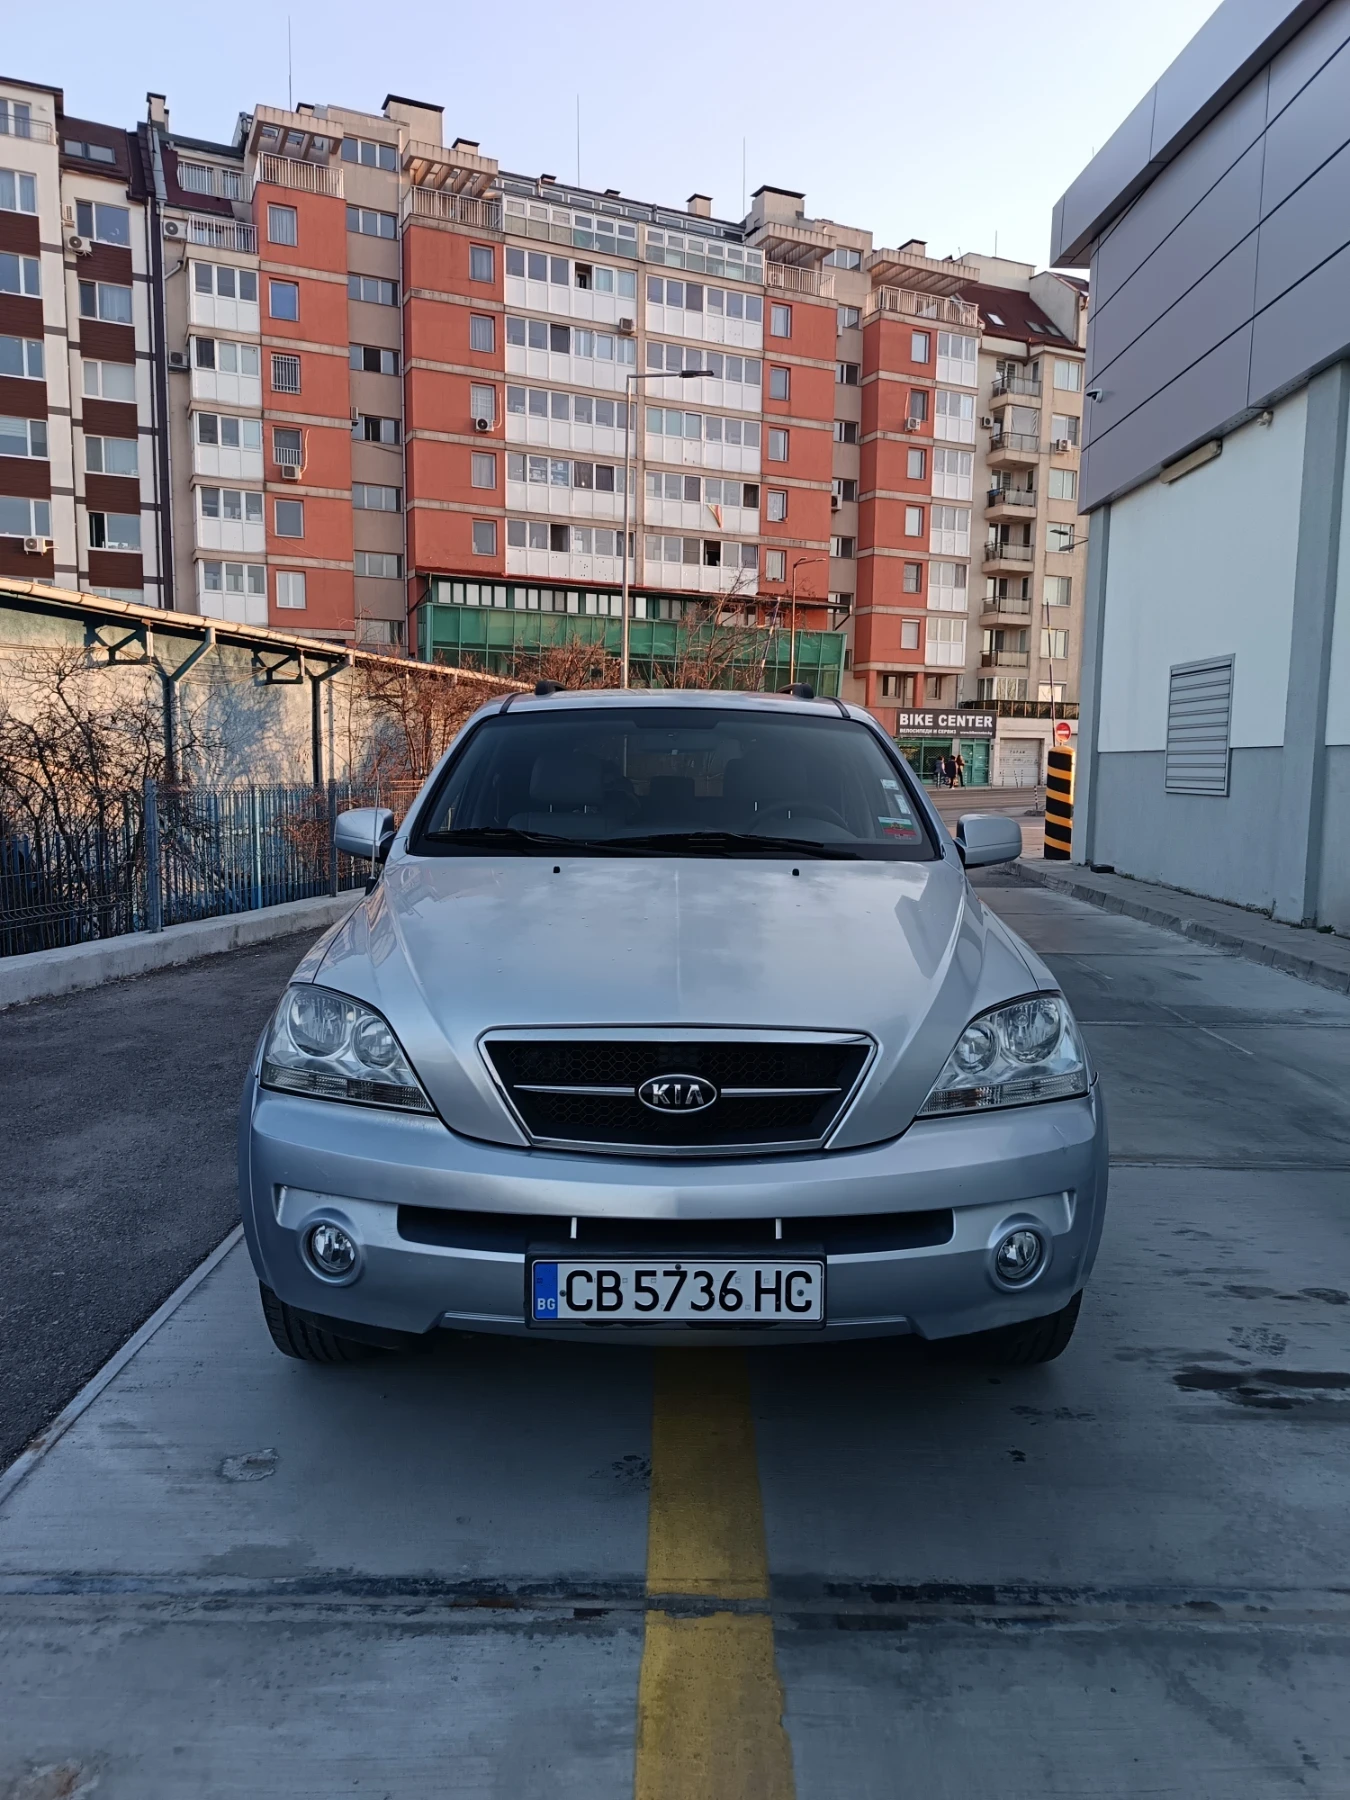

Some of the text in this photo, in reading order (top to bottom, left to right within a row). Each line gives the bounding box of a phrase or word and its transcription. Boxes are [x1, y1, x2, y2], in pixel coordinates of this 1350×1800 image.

[899, 713, 993, 728] BIKE CENTER
[652, 1083, 704, 1104] KIA
[537, 1298, 556, 1311] BG
